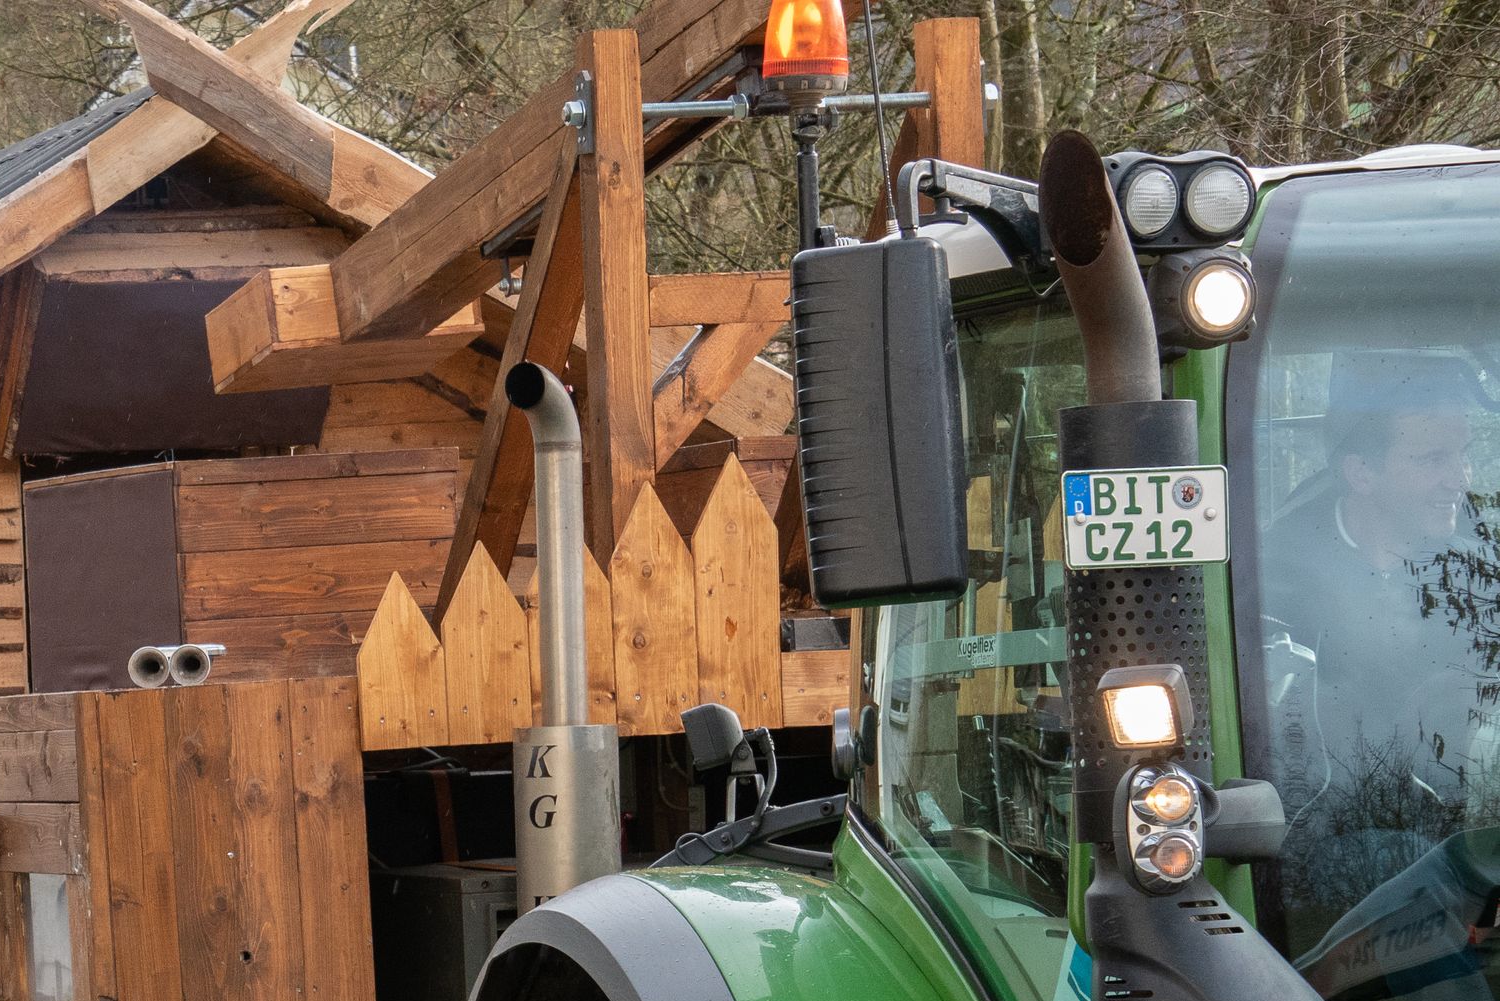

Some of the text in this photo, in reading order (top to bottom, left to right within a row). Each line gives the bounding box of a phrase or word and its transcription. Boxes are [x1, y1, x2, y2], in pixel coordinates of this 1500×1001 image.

[1074, 500, 1084, 513] D
[1093, 475, 1171, 516] BIT
[1085, 519, 1194, 562] CZ 12
[958, 637, 994, 658] Kugelflex
